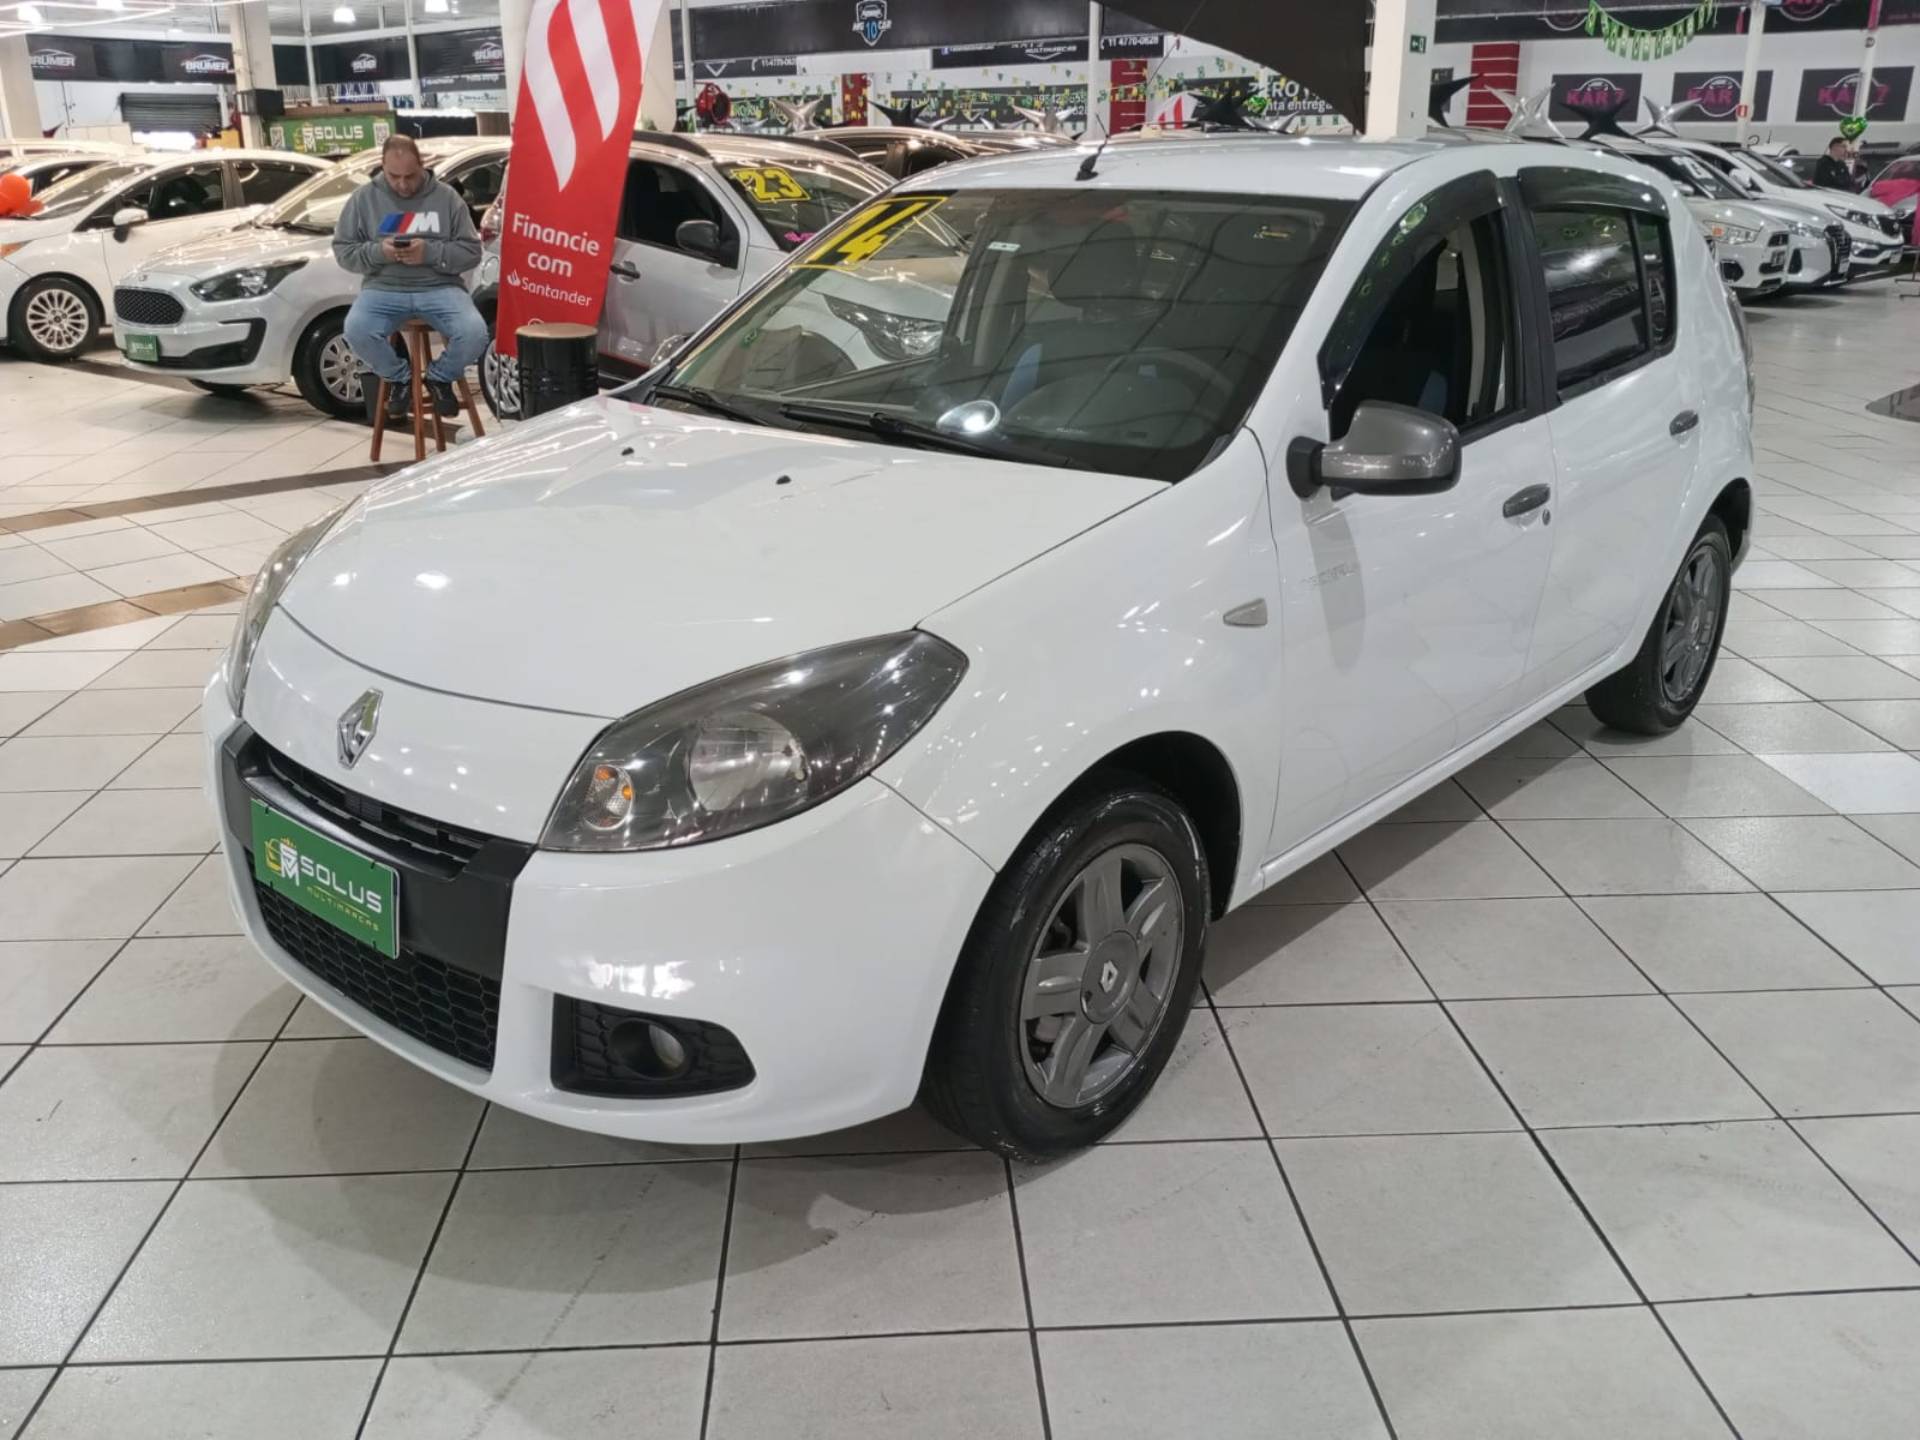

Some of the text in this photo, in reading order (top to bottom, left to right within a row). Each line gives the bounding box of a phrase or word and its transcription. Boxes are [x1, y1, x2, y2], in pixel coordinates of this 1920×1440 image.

[314, 126, 364, 139] SOLUS
[735, 170, 803, 199] 23
[407, 211, 441, 234] M
[512, 212, 600, 257] Financie
[804, 202, 929, 263] 14
[527, 252, 573, 278] com
[521, 277, 593, 307] Santander
[300, 855, 382, 913] SOLUS
